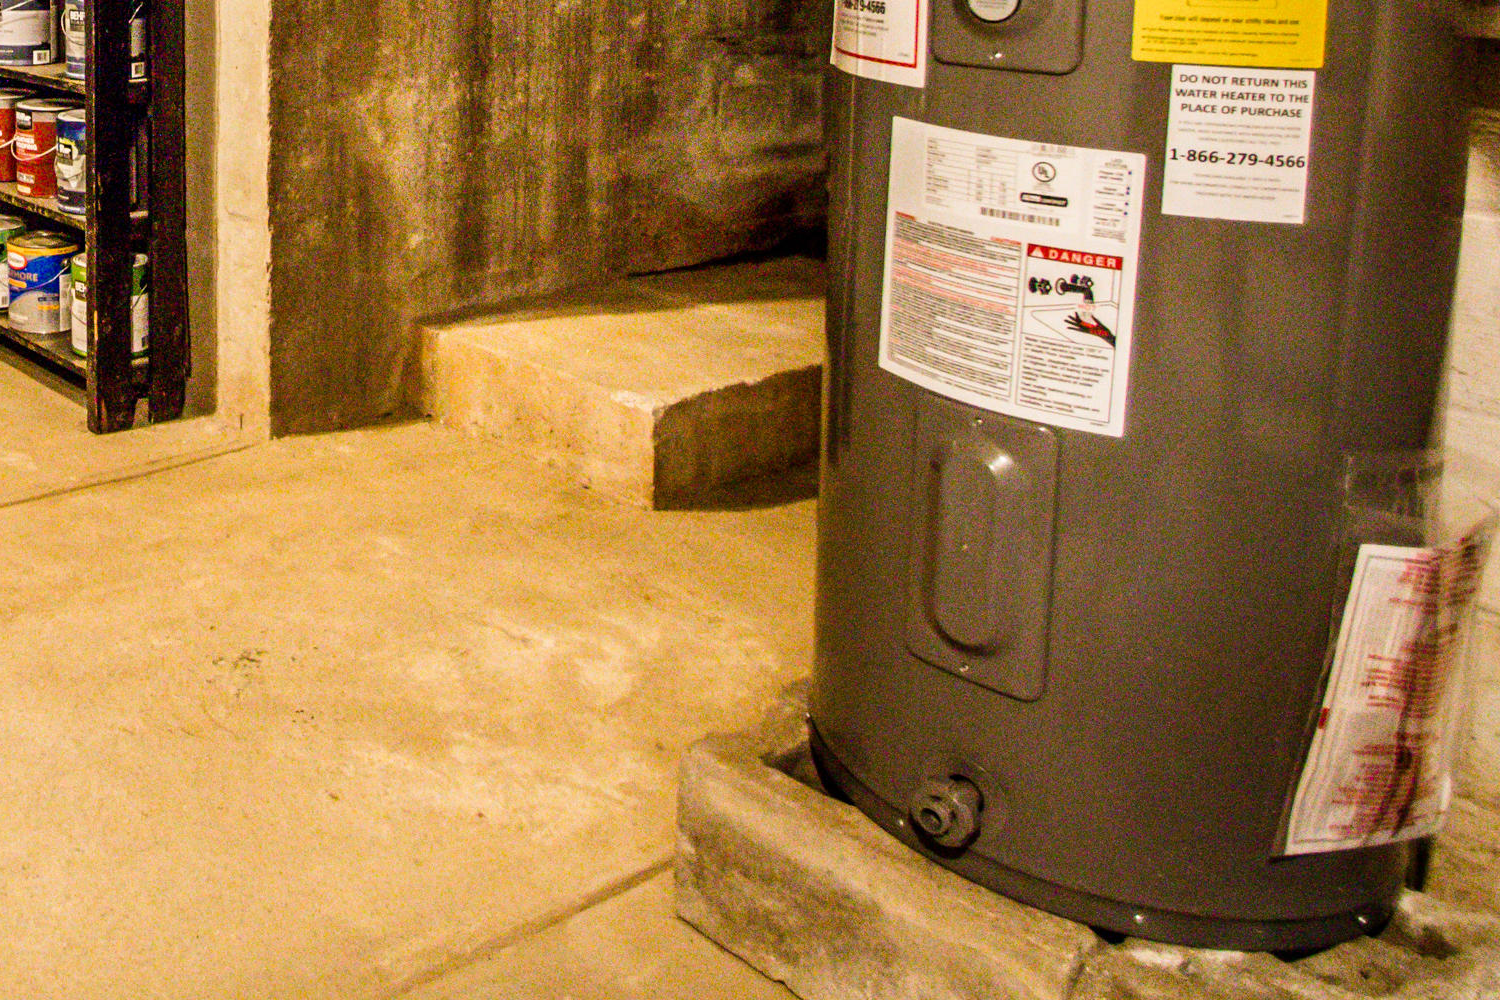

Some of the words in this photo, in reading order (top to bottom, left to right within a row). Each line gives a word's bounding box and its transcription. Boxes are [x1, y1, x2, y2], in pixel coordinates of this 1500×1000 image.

[1179, 74, 1198, 83] DO
[1201, 75, 1228, 85] NOT
[1231, 77, 1279, 88] RETURN
[1283, 79, 1308, 89] THIS
[1175, 88, 1217, 99] WATER
[1221, 91, 1266, 101] HEATER
[1270, 93, 1285, 103] TO
[1288, 94, 1309, 104] THE
[1180, 103, 1218, 114] PLACE
[1221, 105, 1237, 115] OF
[1240, 106, 1303, 118] PURCHASE
[1170, 148, 1306, 169] 1-866-279-4566
[1048, 248, 1117, 269] DANGER
